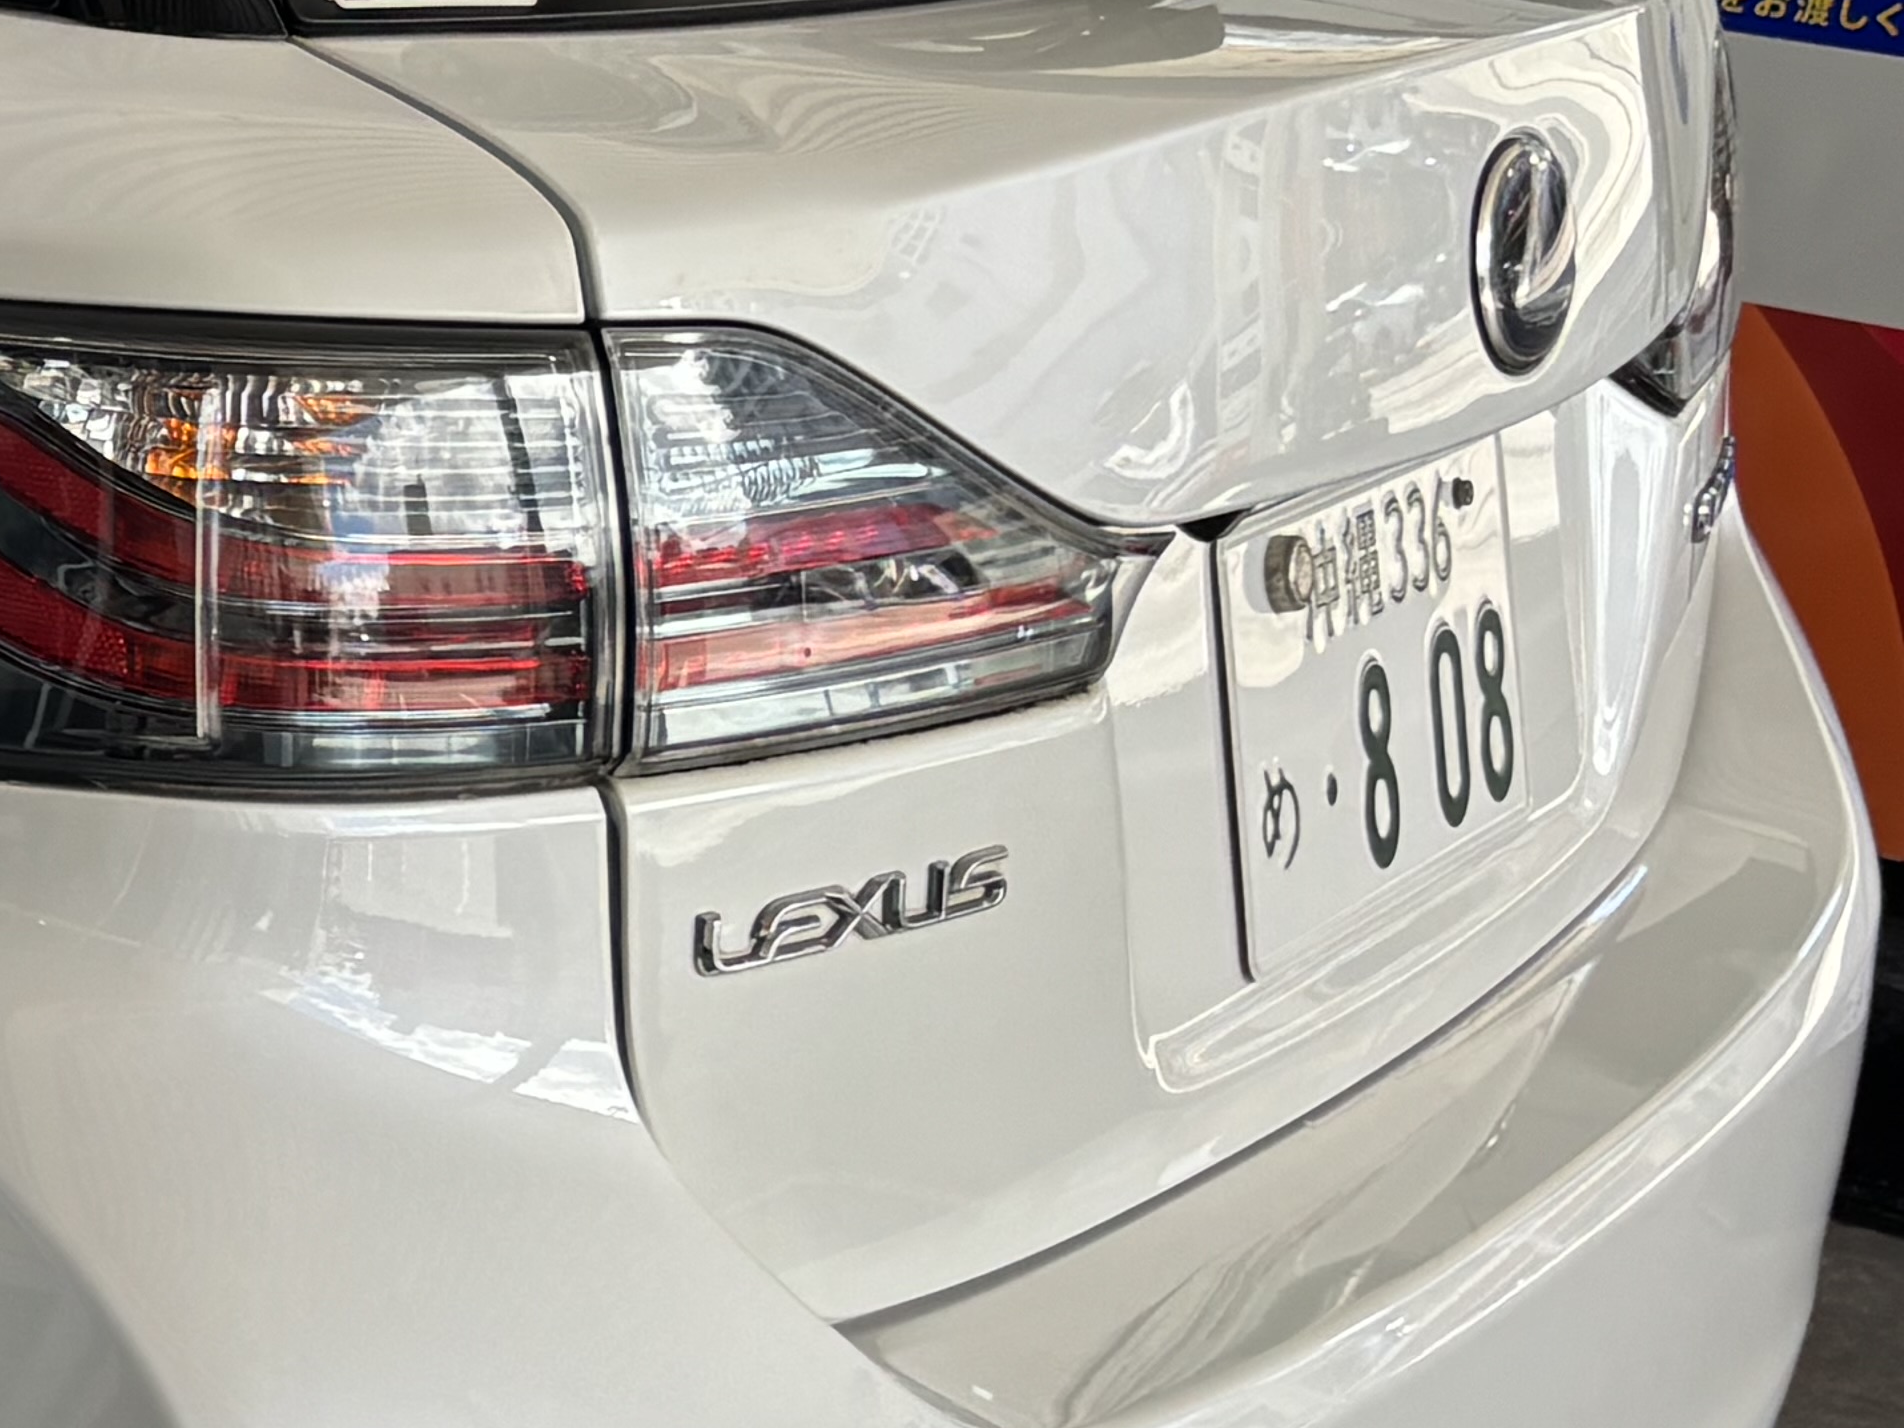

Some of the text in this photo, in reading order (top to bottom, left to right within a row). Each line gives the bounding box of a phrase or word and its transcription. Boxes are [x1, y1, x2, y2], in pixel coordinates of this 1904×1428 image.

[1384, 469, 1453, 602] 336
[1262, 767, 1301, 870] め
[693, 843, 1009, 978] LEXUS
